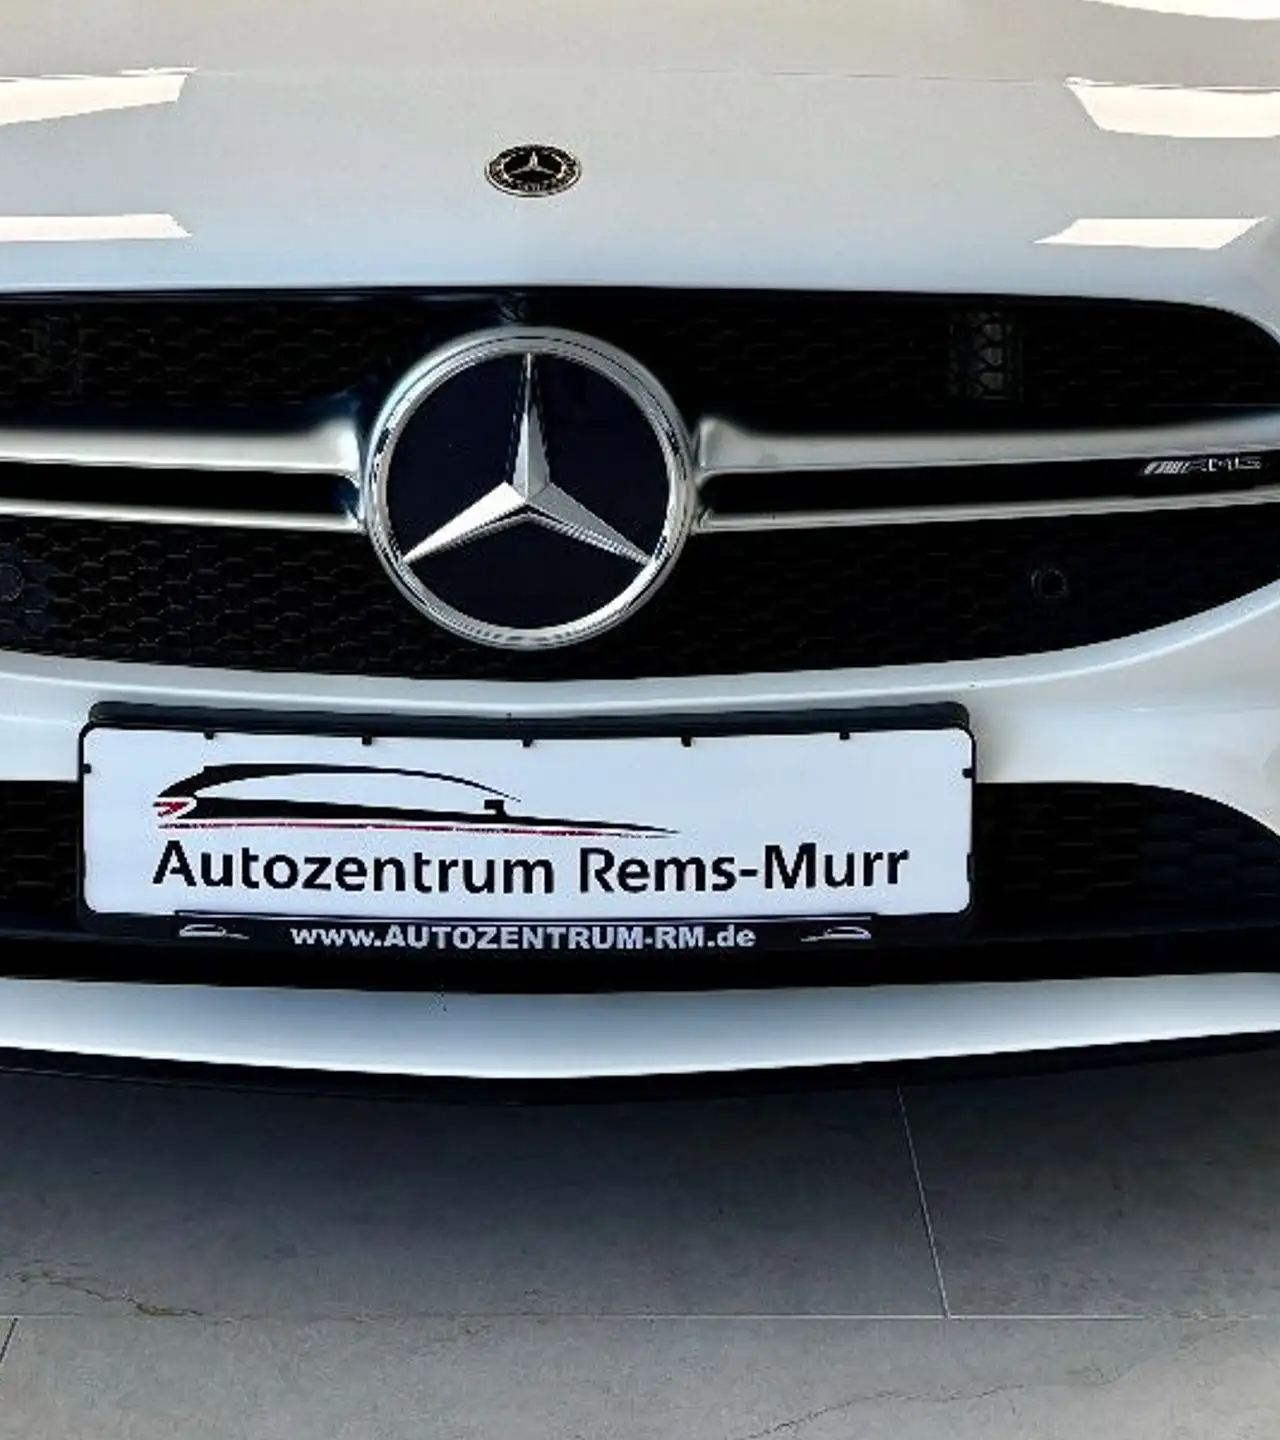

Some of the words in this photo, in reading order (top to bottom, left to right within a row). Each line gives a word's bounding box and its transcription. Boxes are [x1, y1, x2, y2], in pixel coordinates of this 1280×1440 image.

[153, 840, 554, 894] Autozentrum
[580, 843, 910, 894] Rems-Murr
[290, 922, 756, 950] www.AUTOZENTRUM-RM.de
